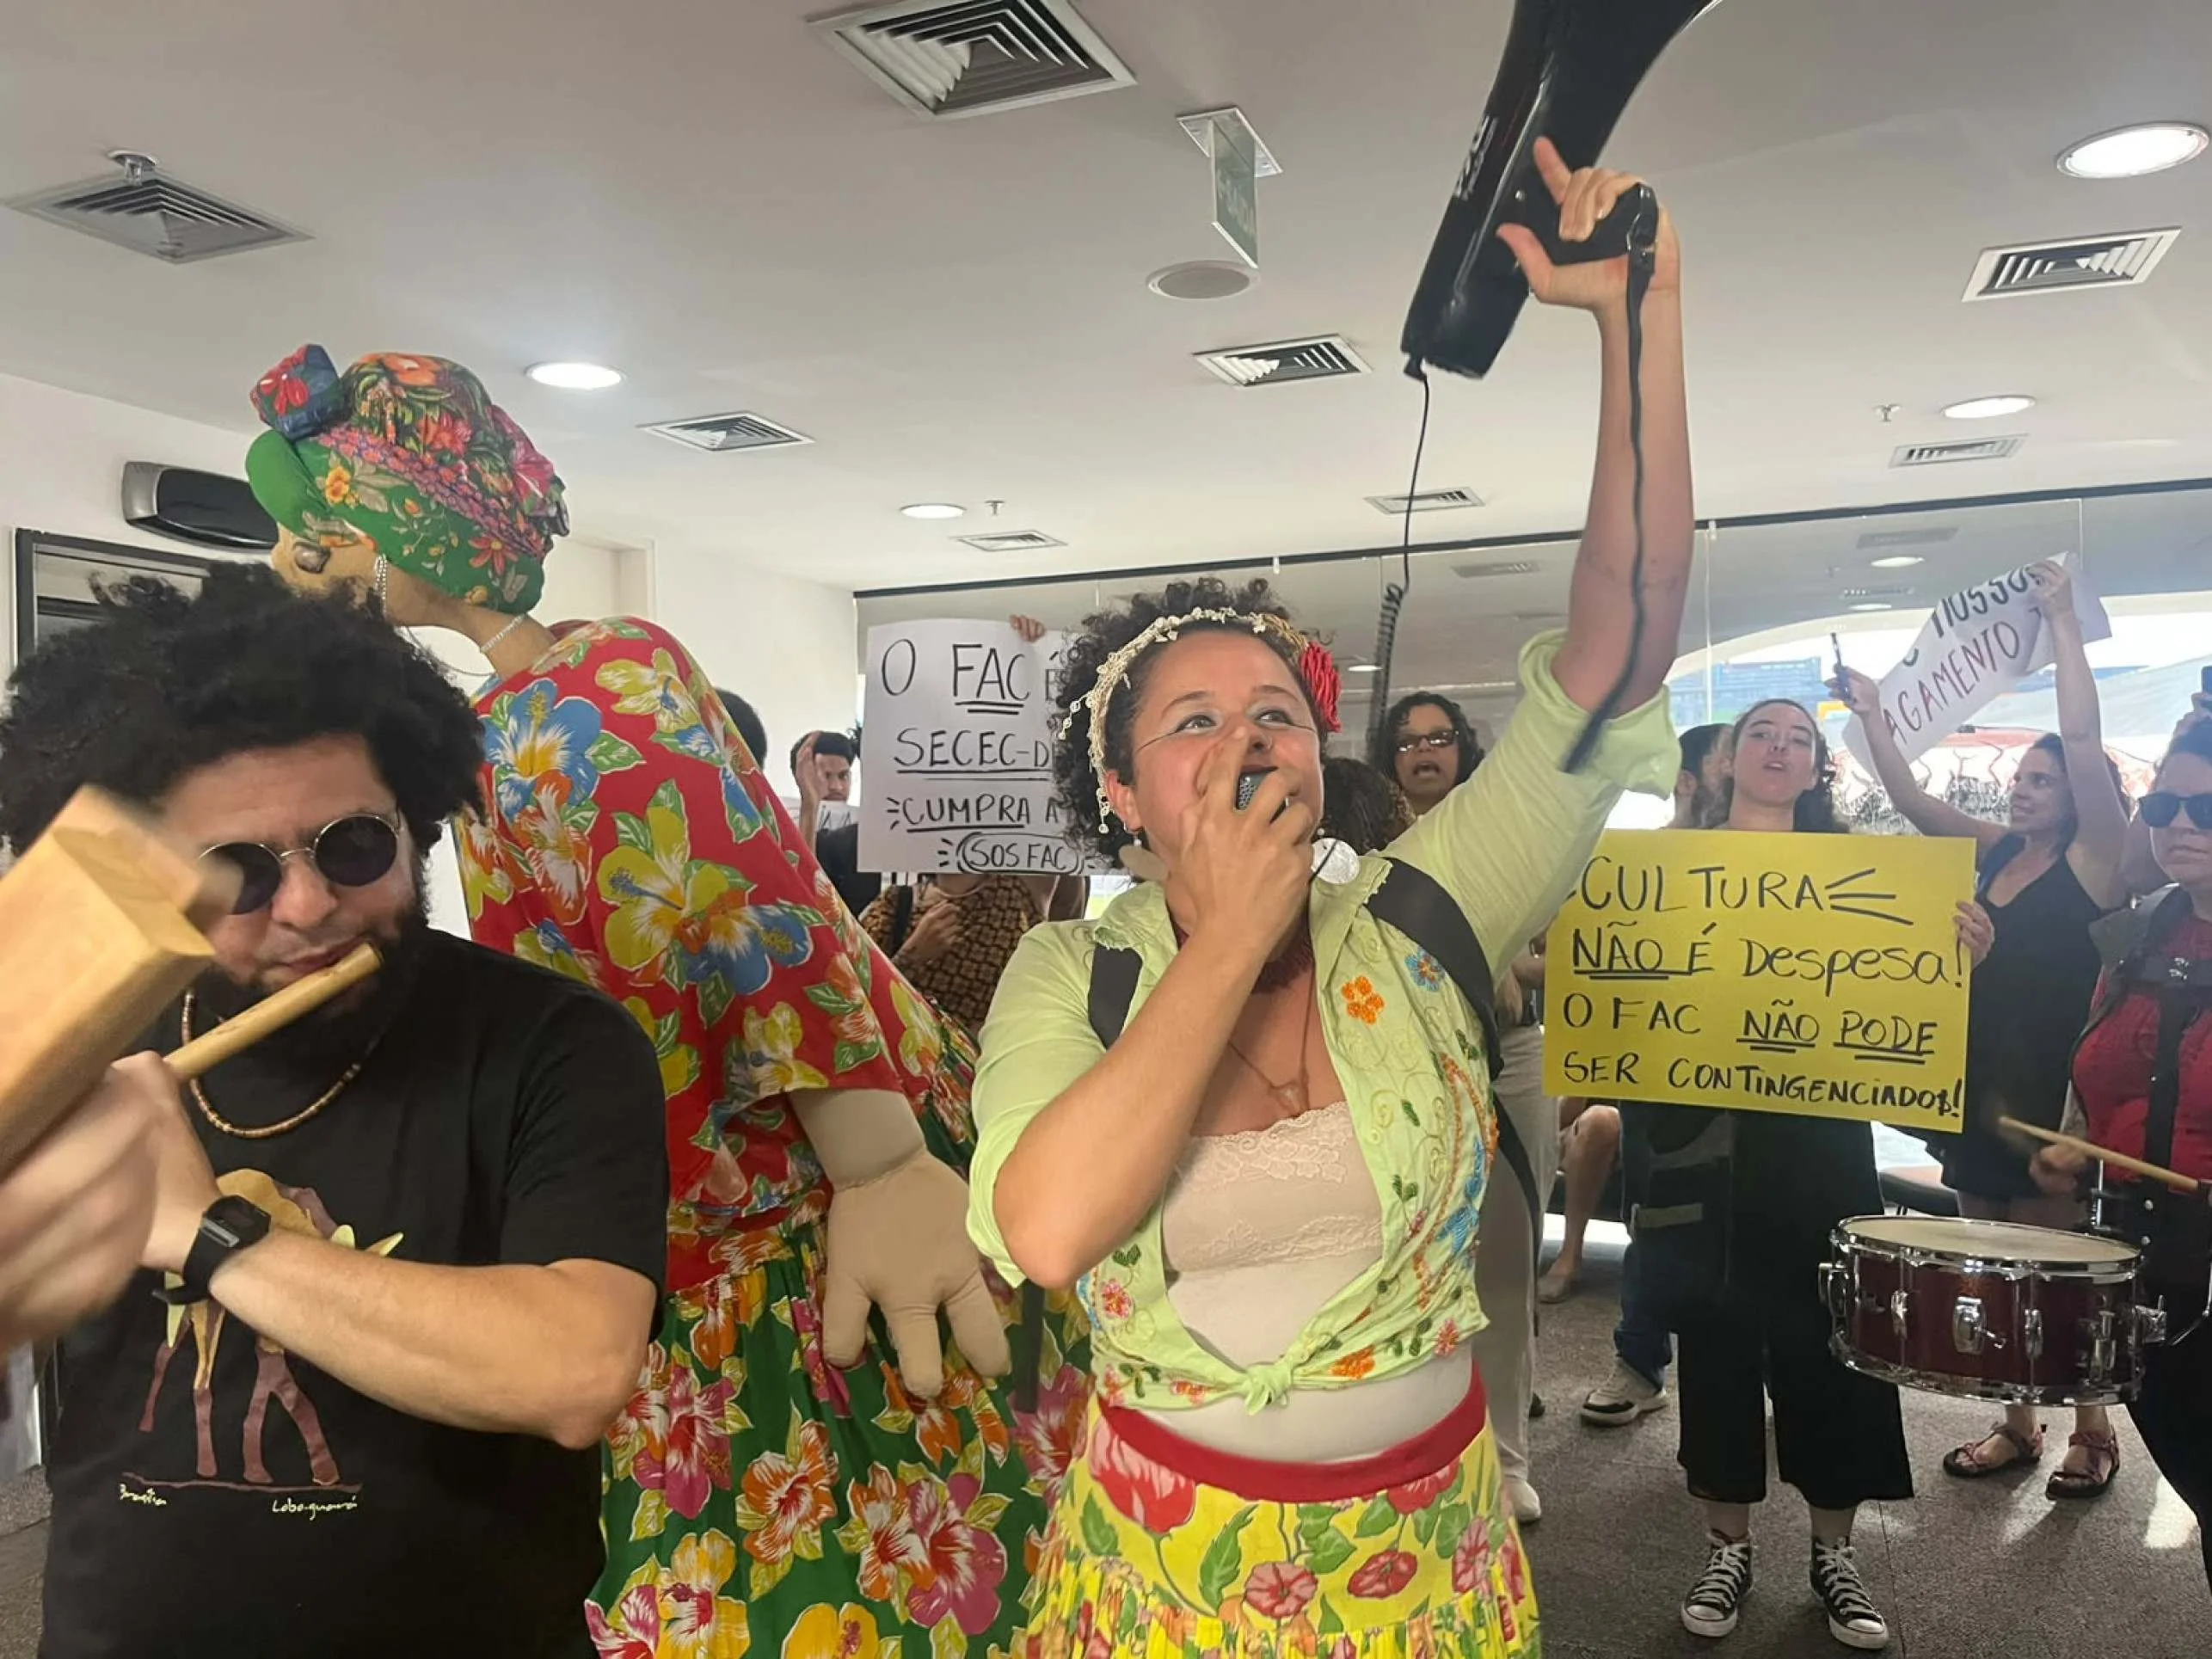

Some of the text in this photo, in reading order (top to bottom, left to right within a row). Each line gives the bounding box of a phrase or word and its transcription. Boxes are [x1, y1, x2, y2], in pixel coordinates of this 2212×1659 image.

[882, 638, 916, 696] O
[952, 643, 1032, 701] FAC
[894, 728, 1055, 767] SECEC-D
[902, 793, 1030, 825] CUMPRA
[970, 839, 1067, 870] SOS FAC
[1581, 855, 1824, 912] CULTURA
[1573, 921, 1662, 973] NÃO
[1689, 922, 1717, 974] É
[1563, 993, 1938, 1056] O FAC NÃO PODE
[1564, 1051, 1639, 1084] SER
